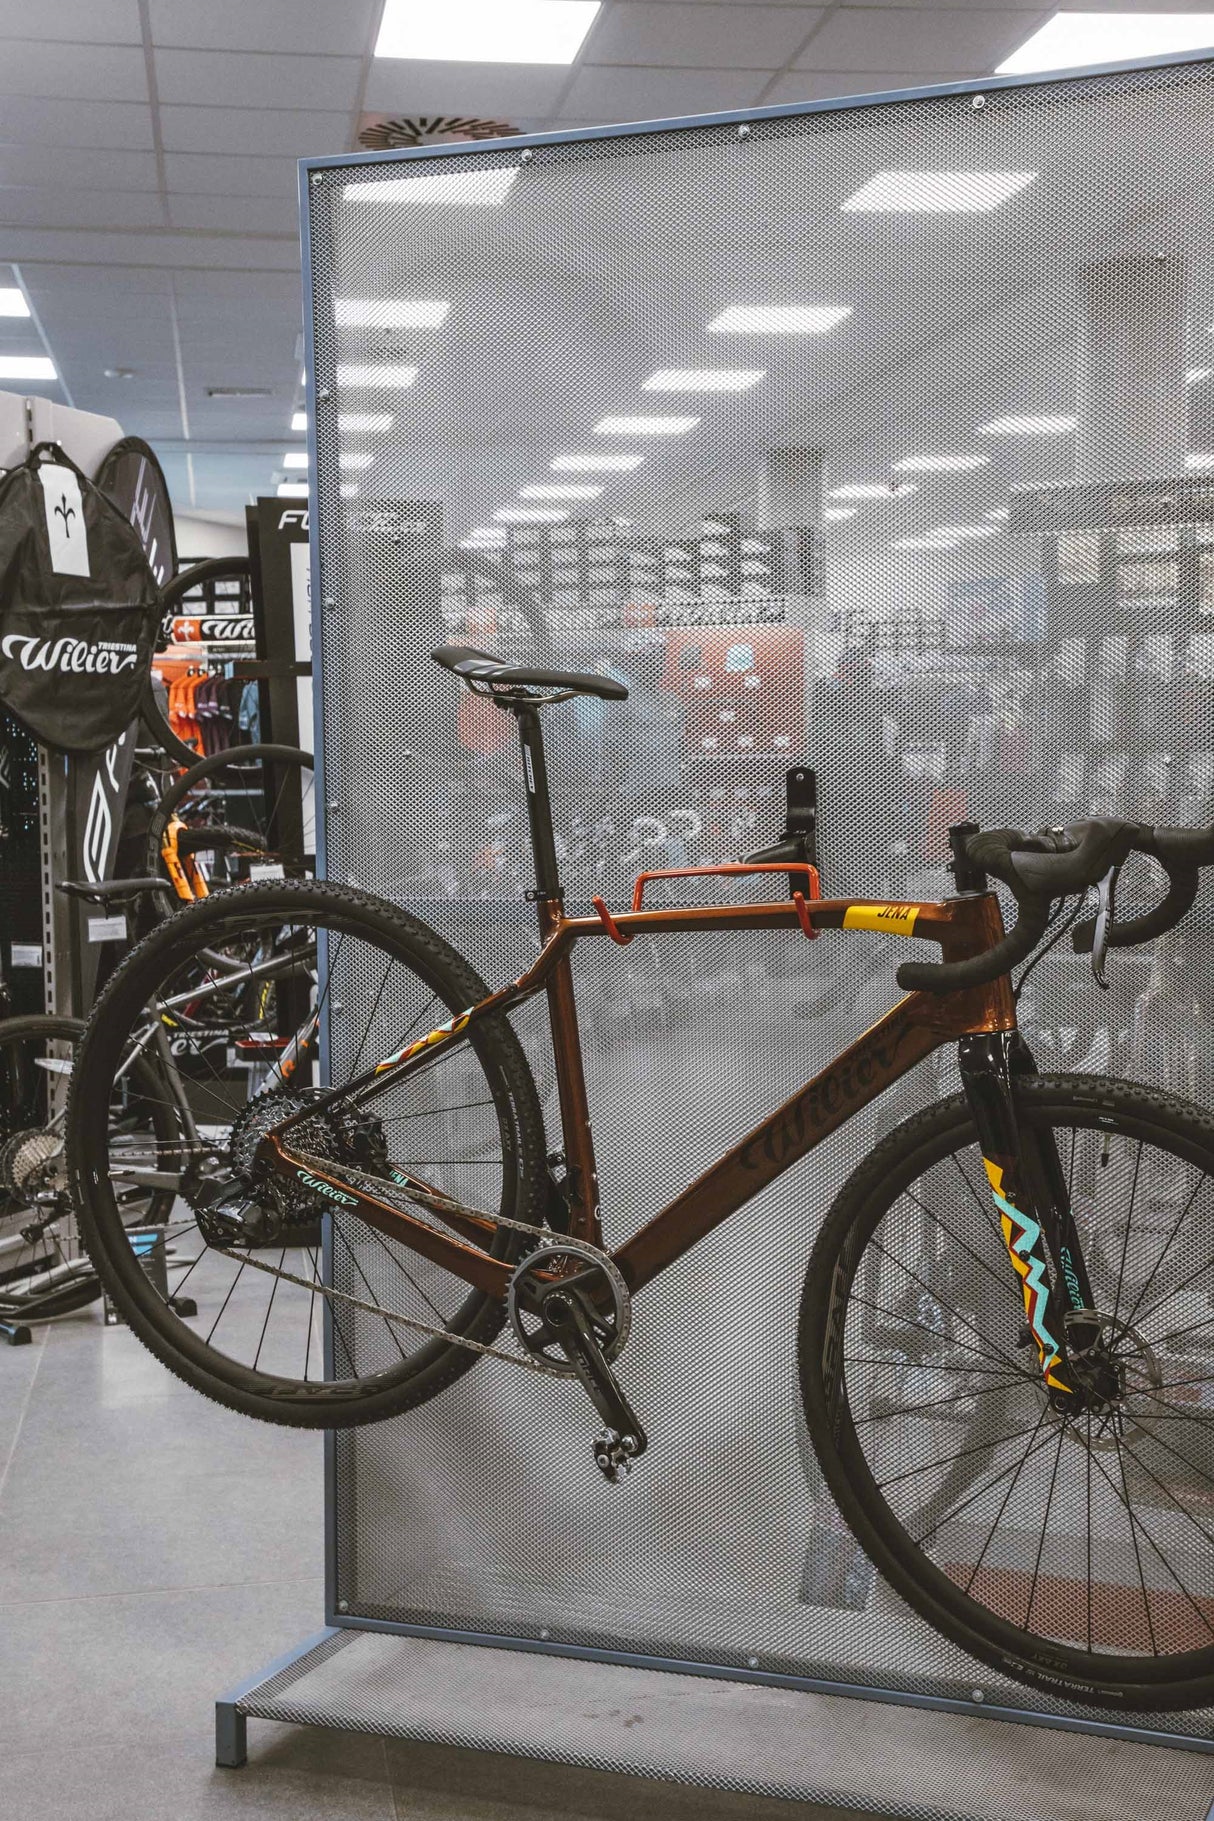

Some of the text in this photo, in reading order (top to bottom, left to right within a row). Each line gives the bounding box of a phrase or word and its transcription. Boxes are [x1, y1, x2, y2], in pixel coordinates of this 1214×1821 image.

[2, 634, 138, 674] Wilier
[98, 641, 137, 652] TRIESTINA
[877, 906, 912, 920] JENA
[739, 1021, 913, 1170] Wilier
[297, 1171, 359, 1206] Wilier
